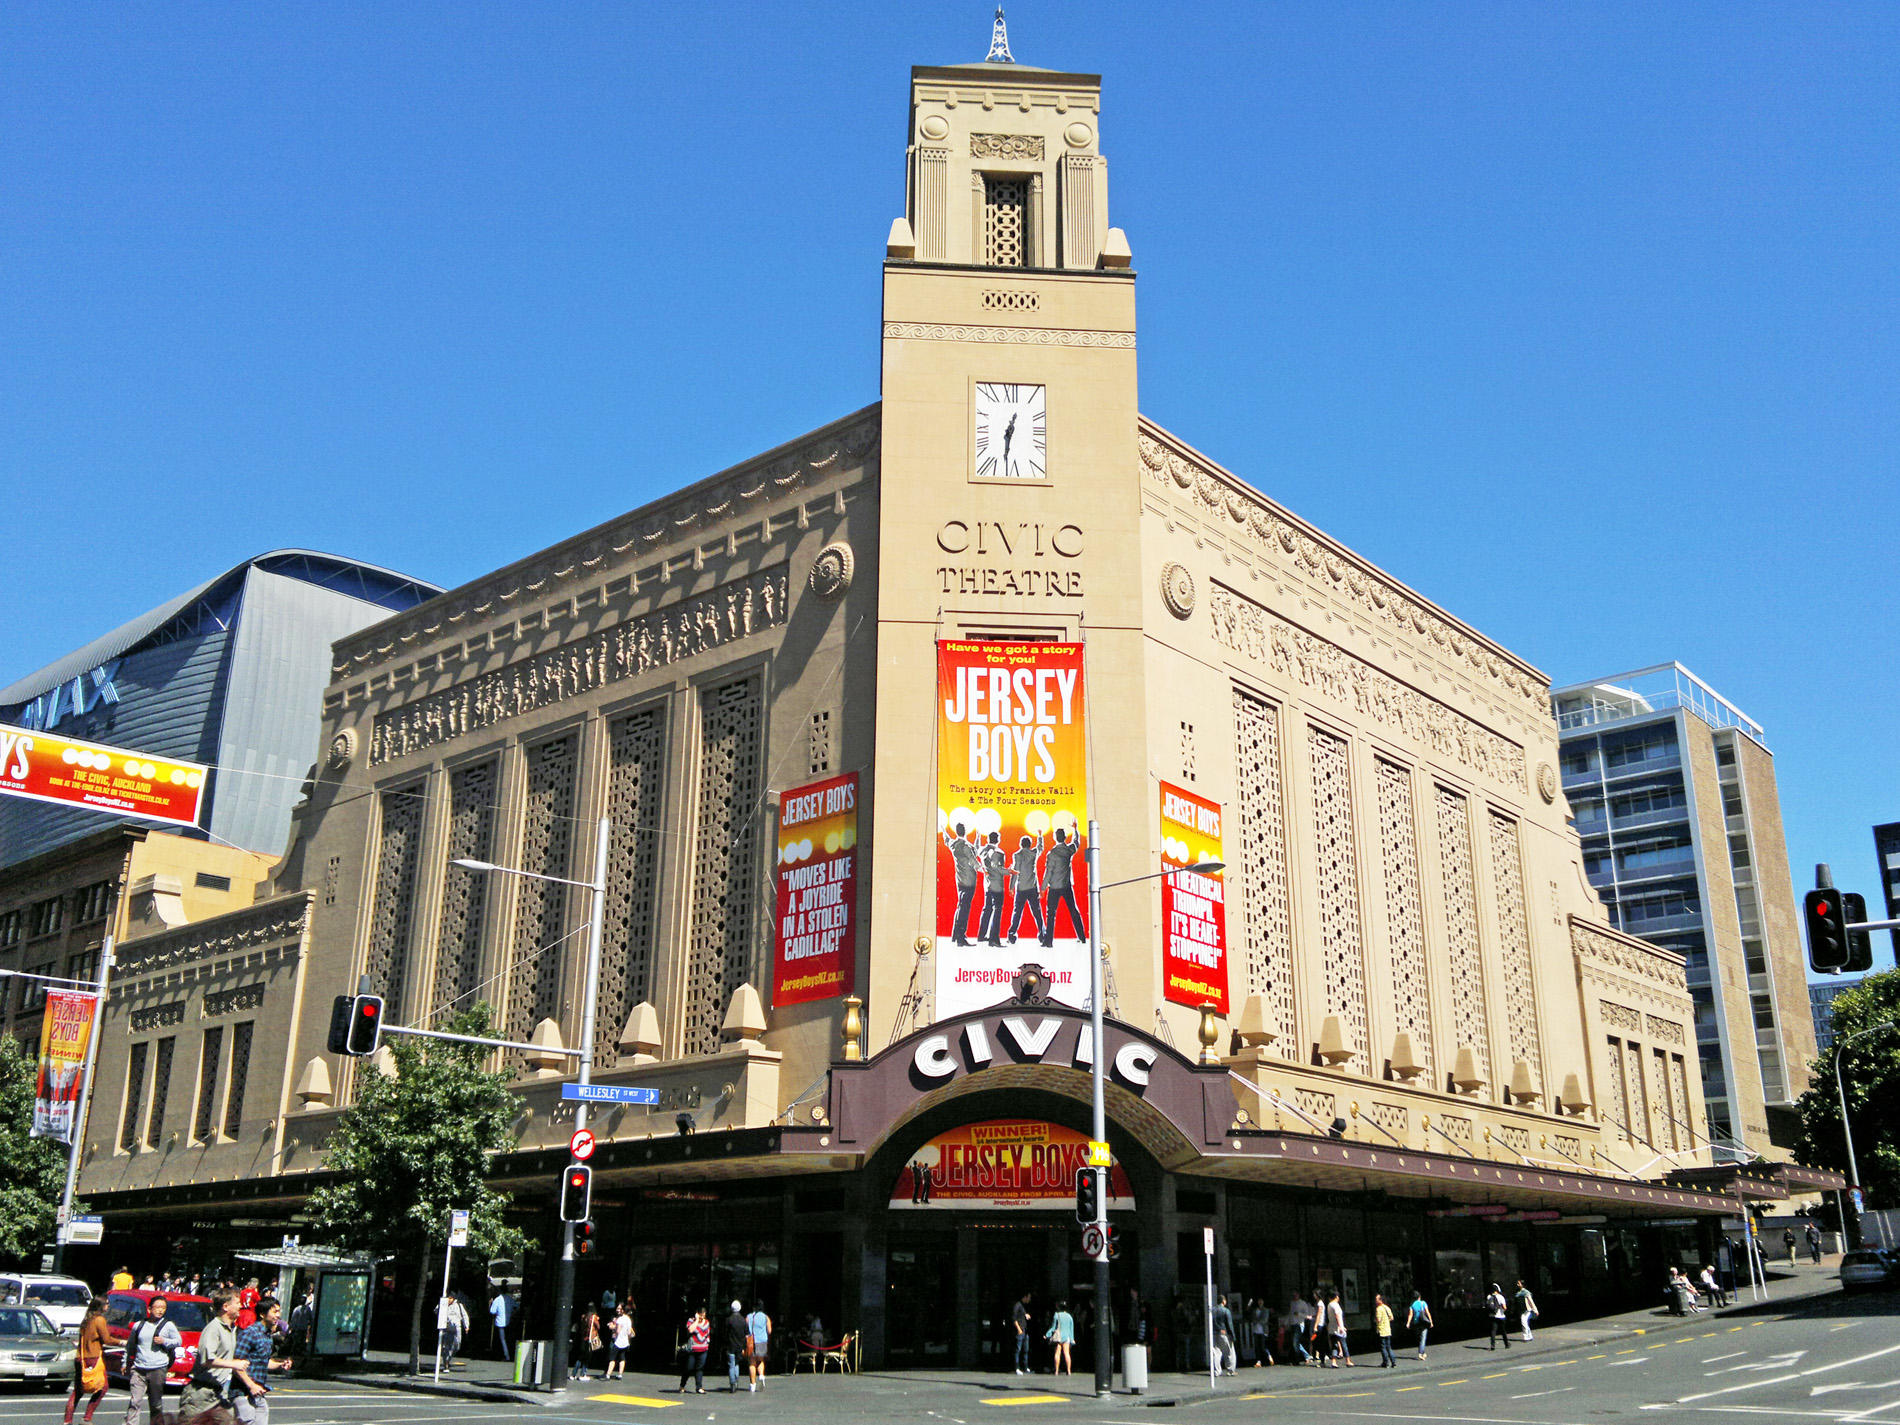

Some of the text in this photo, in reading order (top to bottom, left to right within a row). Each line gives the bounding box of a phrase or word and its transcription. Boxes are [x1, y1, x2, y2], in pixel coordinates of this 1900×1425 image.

[936, 520, 1084, 558] CIVIC
[936, 567, 1084, 597] THEATRE
[946, 643, 1076, 655] Have we got a story
[986, 654, 1036, 664] for you!
[945, 666, 1077, 725] JERSEY
[968, 724, 1055, 783] BOYS
[49, 777, 64, 786] BOOK
[73, 770, 152, 793] THE CIVIC, AUCKLAND
[950, 784, 1074, 795] The story of Frankie Valli
[782, 791, 824, 826] JERSEY
[826, 783, 854, 816] BOYS
[1163, 792, 1198, 828] JERSEY
[1198, 804, 1220, 838] BOYS
[829, 856, 852, 885] LIKE
[1175, 867, 1224, 904] THEATRICAL
[788, 882, 843, 914] A JOYRIDE
[1172, 888, 1216, 923] TRIUMPH.
[782, 904, 848, 938] IN A STOLEN
[1171, 911, 1220, 946] IT'S HEART-
[912, 1016, 1158, 1088] CIVIC
[578, 1086, 620, 1099] WELLESLEY
[974, 1125, 1047, 1138] WINNER!
[930, 1143, 1026, 1188] JERSEY
